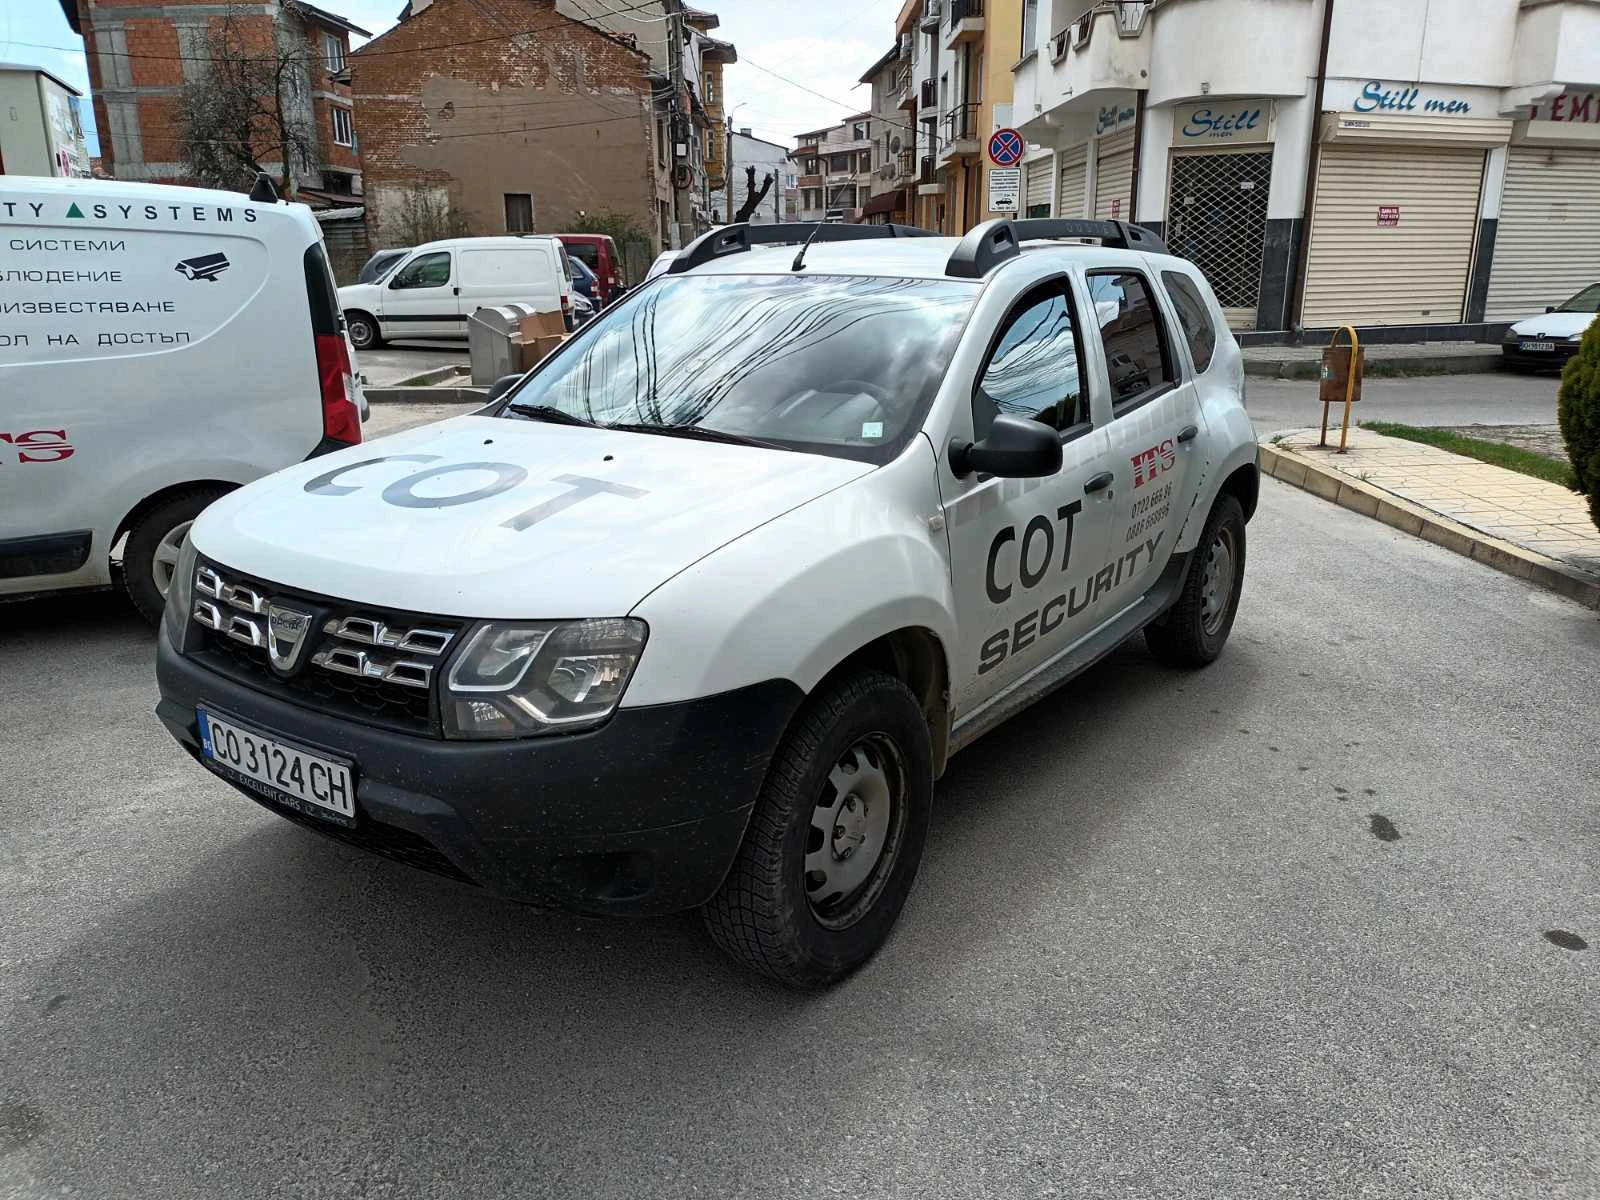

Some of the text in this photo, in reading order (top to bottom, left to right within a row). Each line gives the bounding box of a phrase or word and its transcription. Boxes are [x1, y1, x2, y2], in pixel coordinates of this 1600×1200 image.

[1353, 80, 1471, 113] Still men
[1183, 109, 1260, 137] Still
[94, 204, 257, 222] SYSTEMS
[10, 239, 125, 251] СИСТЕМИ
[0, 301, 176, 313] ИЗВЕСТЯВАНЕ
[48, 334, 79, 345] НА
[98, 332, 190, 347] ДОСТЪП
[1131, 439, 1175, 489] ITS
[977, 529, 1165, 675] SECURITY
[239, 774, 277, 801] EXCELLENT
[279, 795, 301, 811] CARS
